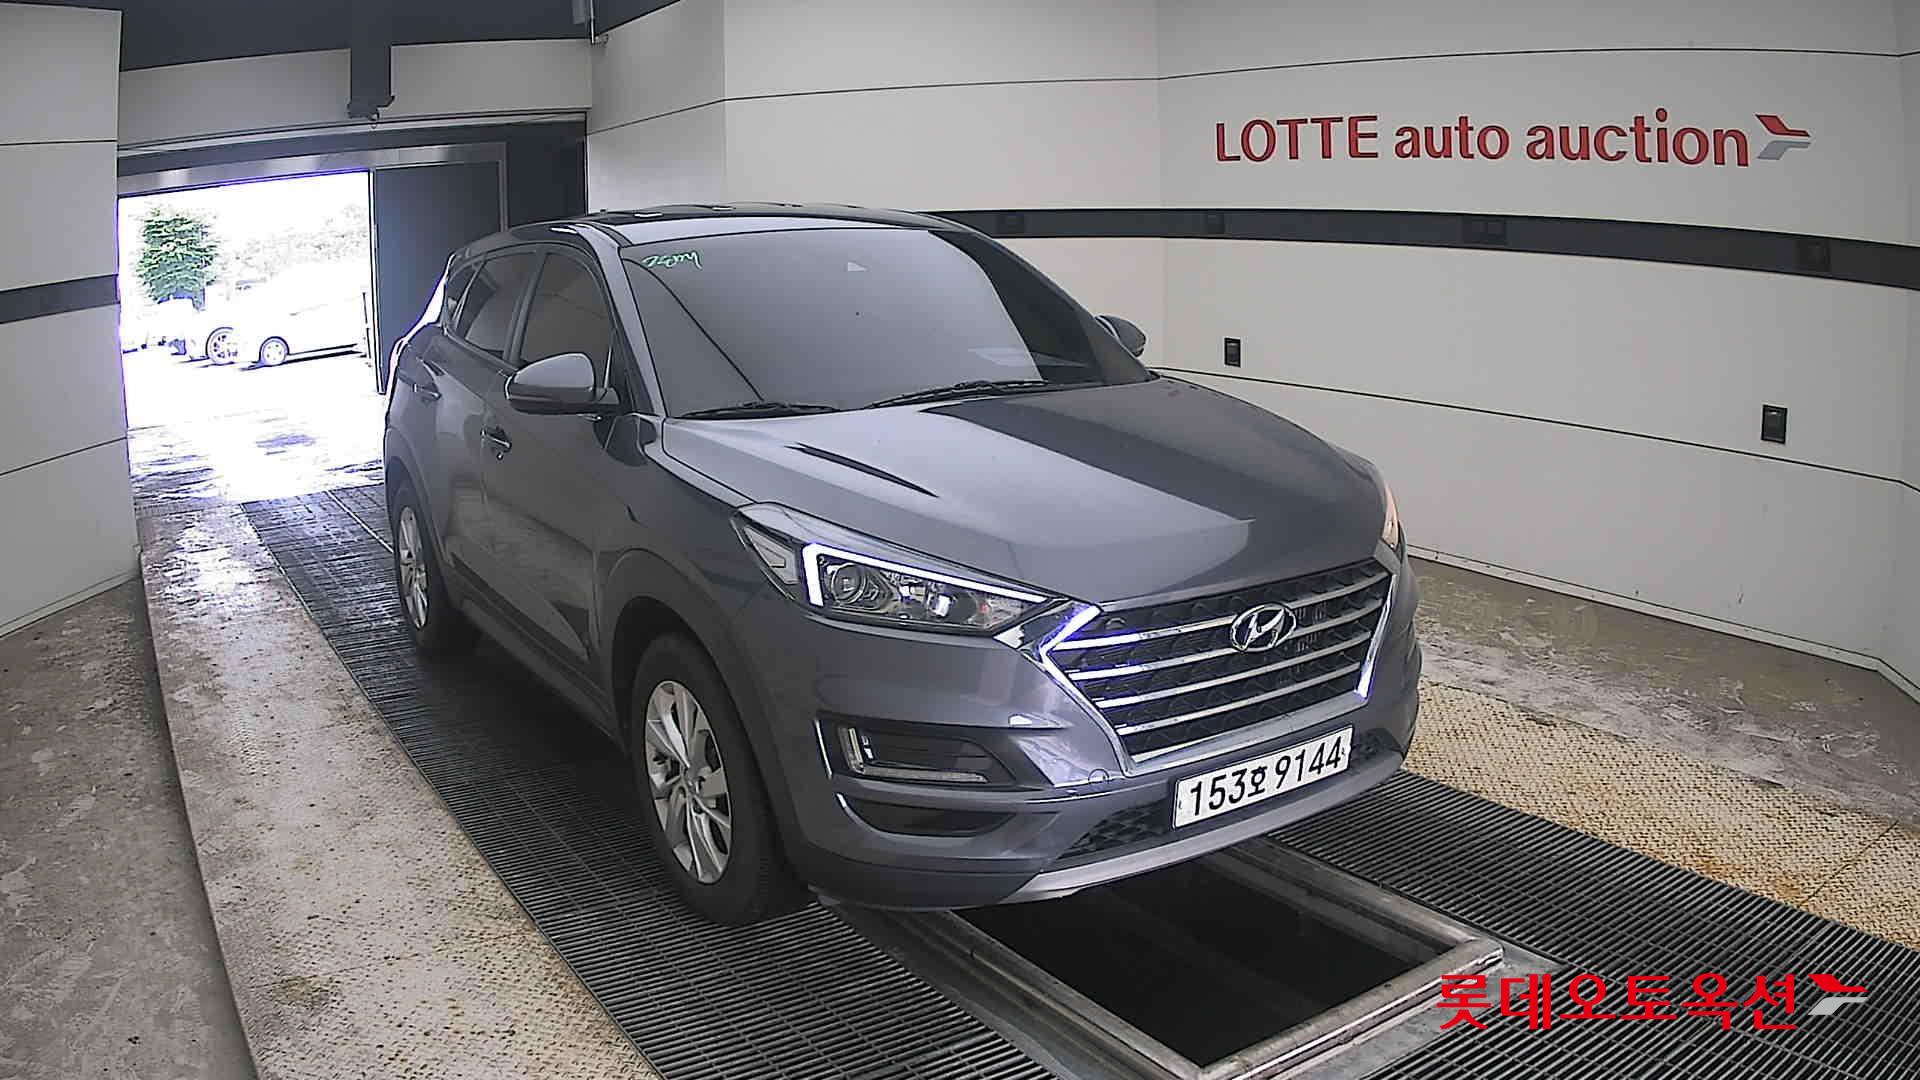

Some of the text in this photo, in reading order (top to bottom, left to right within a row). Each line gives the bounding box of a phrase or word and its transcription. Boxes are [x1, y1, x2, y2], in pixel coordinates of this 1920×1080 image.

[1214, 107, 1750, 168] LOTTE auto auction
[1275, 735, 1343, 789] 9144
